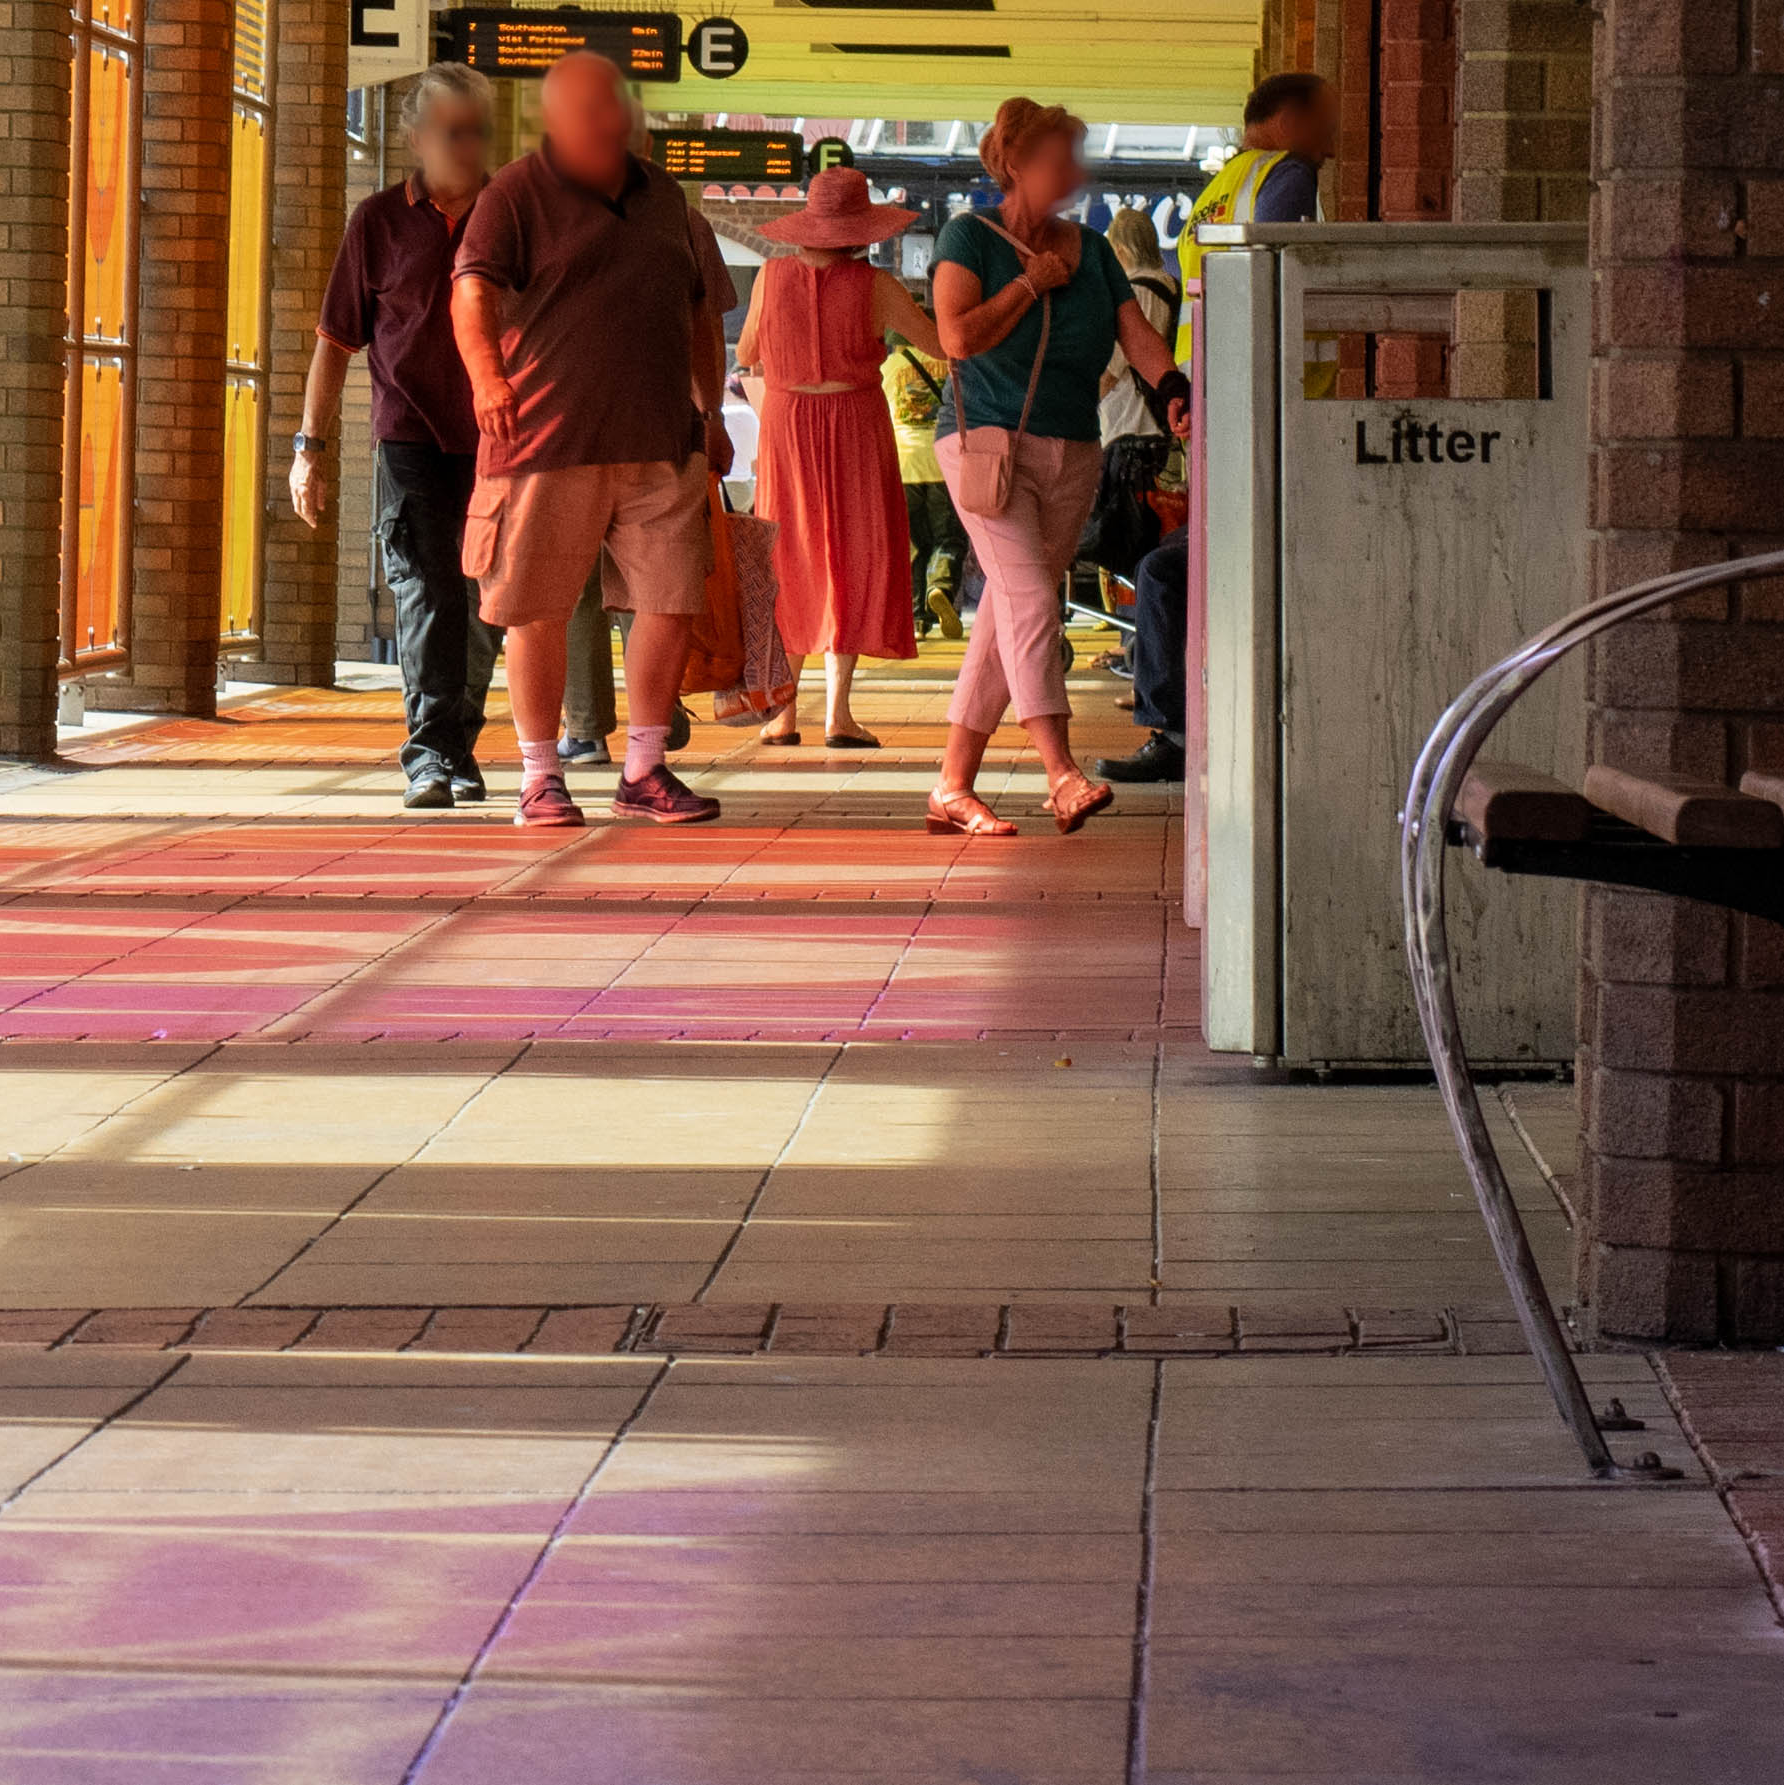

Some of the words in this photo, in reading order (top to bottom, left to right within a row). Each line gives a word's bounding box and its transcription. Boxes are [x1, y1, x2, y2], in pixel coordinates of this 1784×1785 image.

[498, 23, 567, 34] Southampton
[701, 26, 735, 70] E
[1356, 420, 1500, 465] Litter
